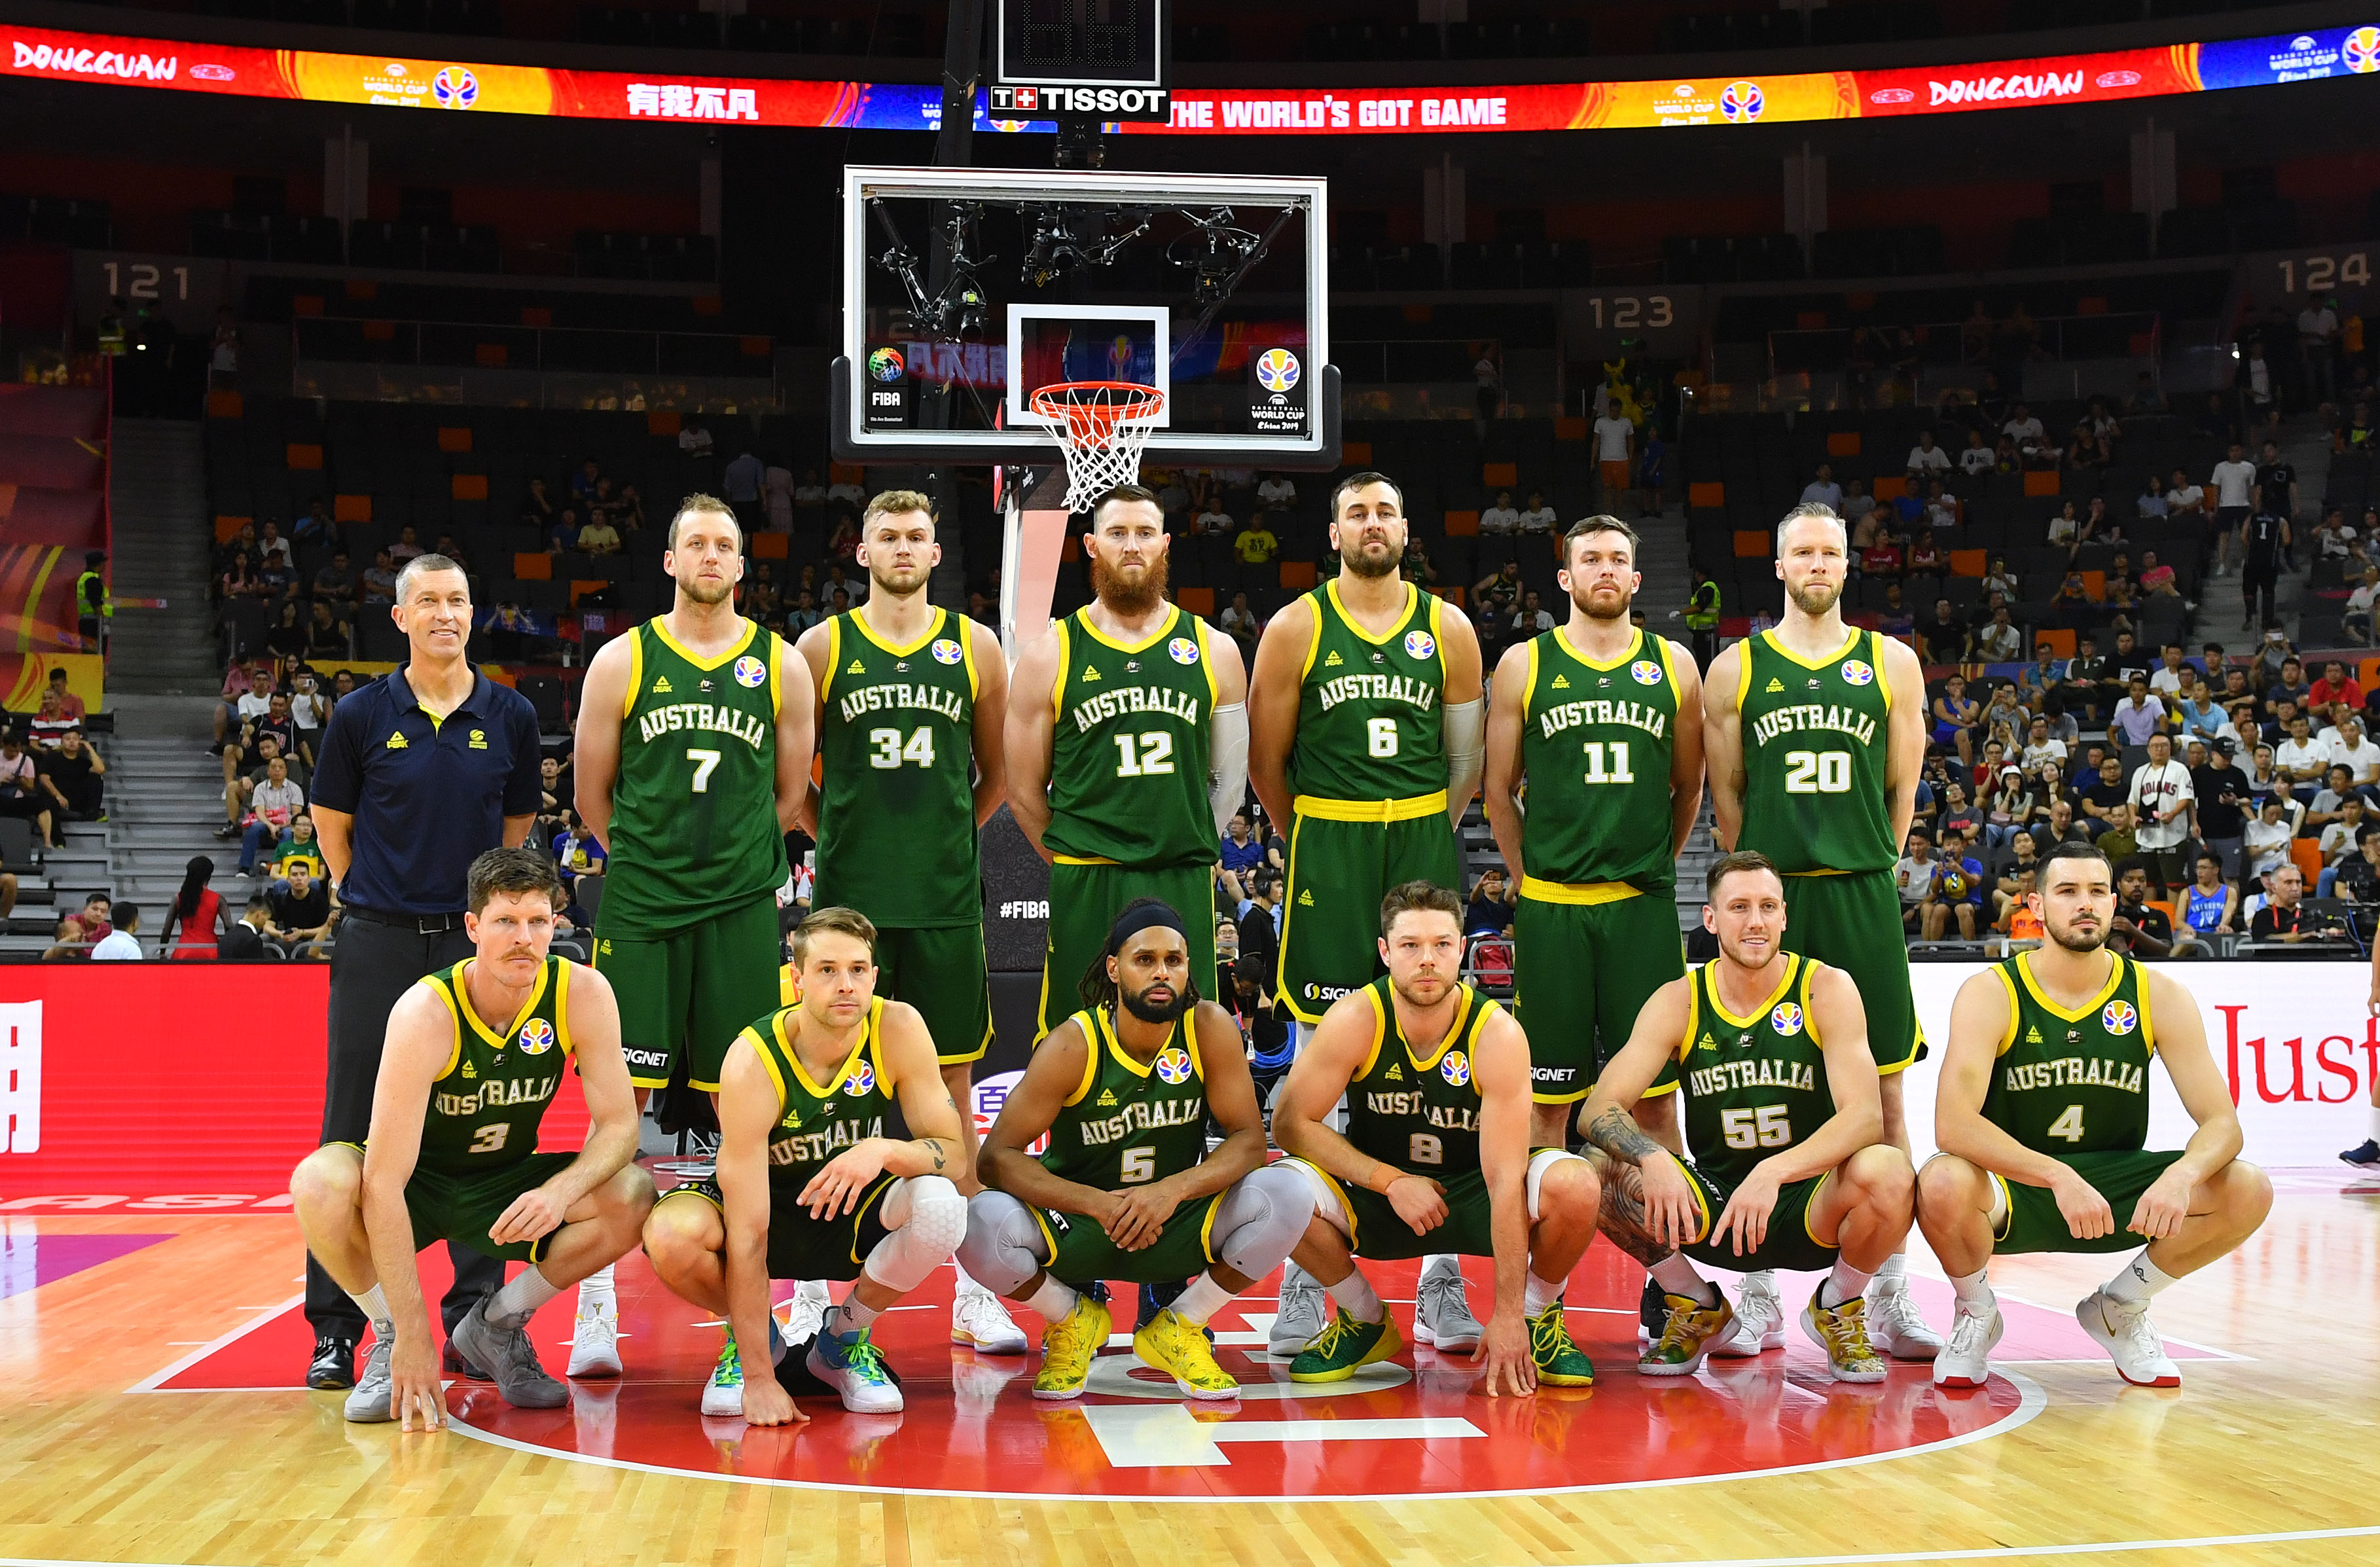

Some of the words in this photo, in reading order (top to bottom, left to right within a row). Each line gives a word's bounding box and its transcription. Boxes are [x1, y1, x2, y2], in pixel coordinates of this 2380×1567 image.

[13, 41, 177, 80] DONGGUAN
[626, 82, 759, 120] 有我不凡
[1040, 88, 1166, 112] TISSOT
[1928, 69, 2083, 105] DONGGUAN
[1165, 100, 1214, 128] THE
[1222, 95, 1350, 128] WORLD'S
[1358, 99, 1413, 126] GOT
[1421, 98, 1507, 126] GAME
[103, 262, 188, 300] 121
[2278, 251, 2371, 292] 124
[1589, 296, 1672, 329] 123
[873, 392, 901, 406] FIBA
[1252, 411, 1285, 420] WORLD
[840, 683, 963, 723] AUSTRALIA
[1073, 686, 1198, 734] AUSTRALIA
[1318, 674, 1435, 711] AUSTRALIA
[640, 704, 765, 751] AUSTRALIA
[1367, 717, 1399, 758] 6
[1540, 700, 1665, 740] AUSTRALIA
[1753, 704, 1876, 747] AUSTRALIA
[870, 726, 935, 769] 34
[1114, 730, 1174, 778] 12
[1583, 742, 1634, 784] 11
[687, 749, 721, 793] 7
[1785, 750, 1851, 793] 20
[1000, 900, 1050, 919] #FIBA
[1320, 986, 1362, 1001] SIGN
[462, 1070, 478, 1079] EAK
[1689, 1058, 1815, 1097] AUSTRALIA
[2006, 1057, 2143, 1094] AUSTRALIA
[1080, 1097, 1202, 1145] AUSTRALIA
[1367, 1090, 1481, 1132] AUSTALIA
[1721, 1104, 1792, 1149] 55
[2047, 1104, 2085, 1142] 4
[468, 1122, 511, 1153] 3
[1409, 1132, 1443, 1164] 8
[1120, 1145, 1156, 1183] 5
